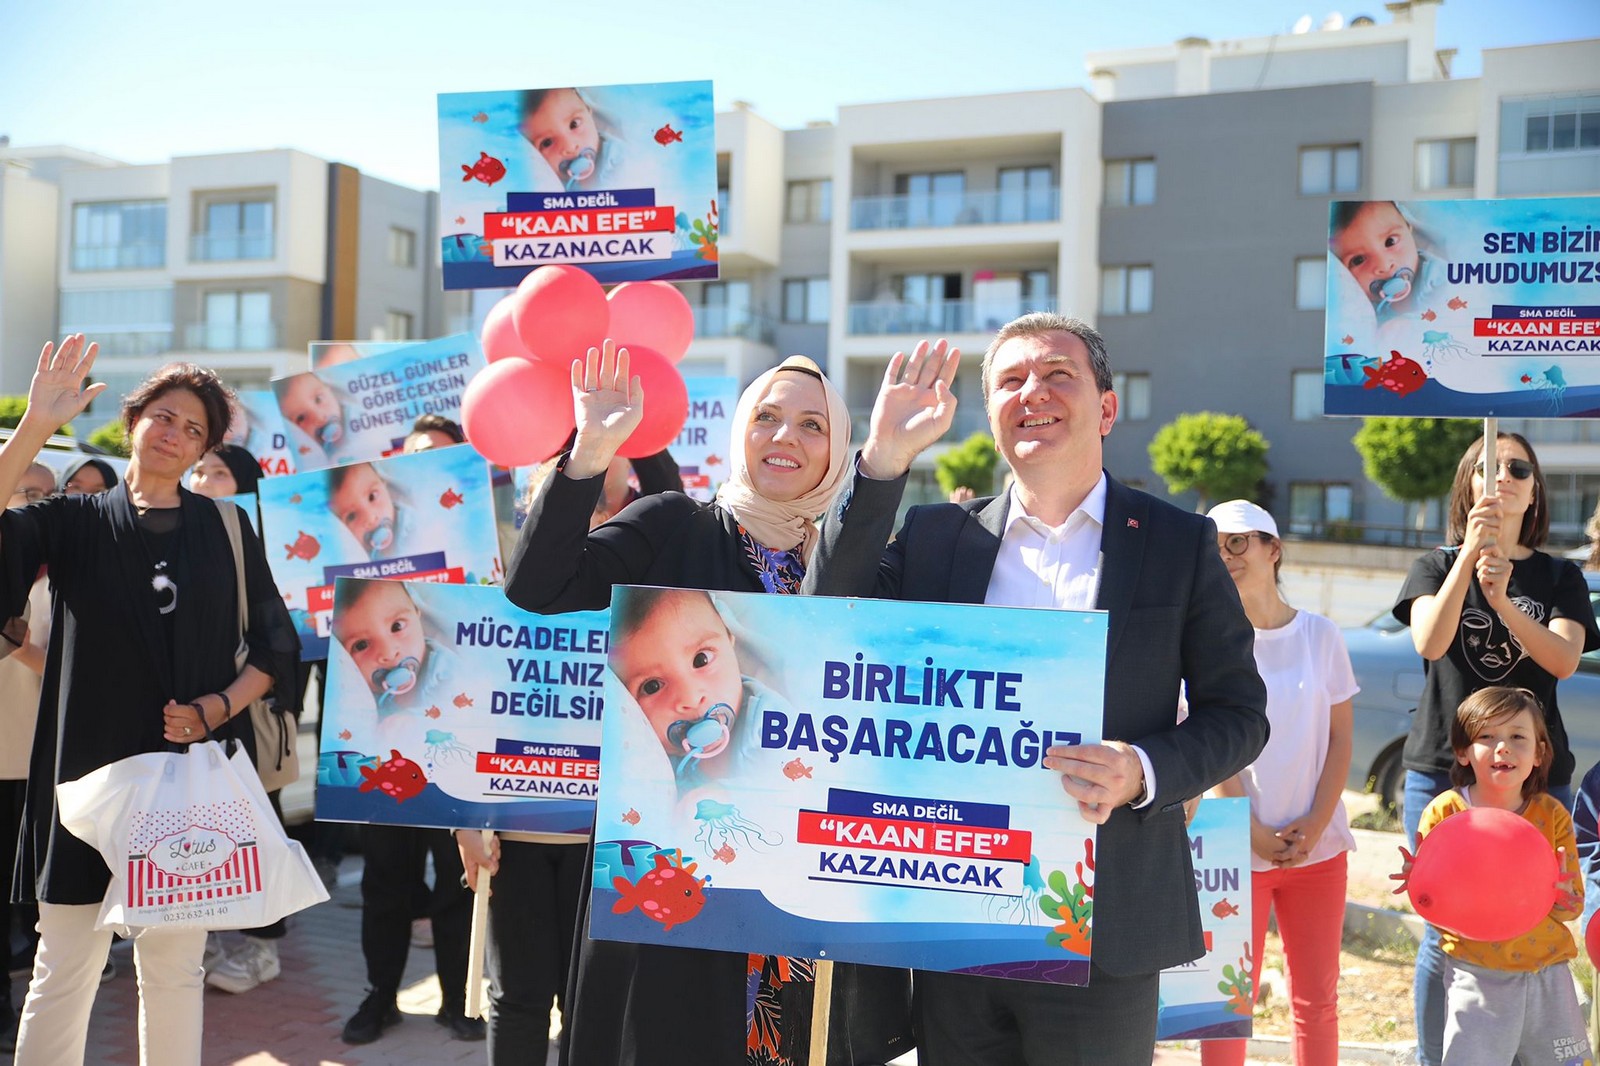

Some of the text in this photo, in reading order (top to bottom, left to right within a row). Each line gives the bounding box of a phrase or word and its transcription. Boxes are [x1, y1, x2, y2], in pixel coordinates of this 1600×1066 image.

[543, 193, 619, 209] SMA DEĞİL
[504, 238, 655, 261] KAZANACAK
[1483, 232, 1536, 254] SEN
[1519, 307, 1577, 318] SMA DEĞİL
[347, 353, 470, 394] GÜZEL GÜNLER
[362, 373, 466, 410] GÖRECEKSİN
[349, 401, 420, 433] GÜNEŞLİ
[687, 400, 725, 420] MA
[353, 558, 417, 578] SMA DEĞİL
[506, 657, 605, 687] YALNIZ
[822, 652, 1024, 713] BİRLİKTE
[522, 745, 580, 758] SMA DEĞİL
[872, 801, 964, 822] SMA DEĞİL
[181, 860, 206, 872] CAFE
[819, 850, 1004, 889] KAZANACAK
[163, 906, 228, 922] 0232 632 41 40
[1552, 1036, 1577, 1048] KRAL
